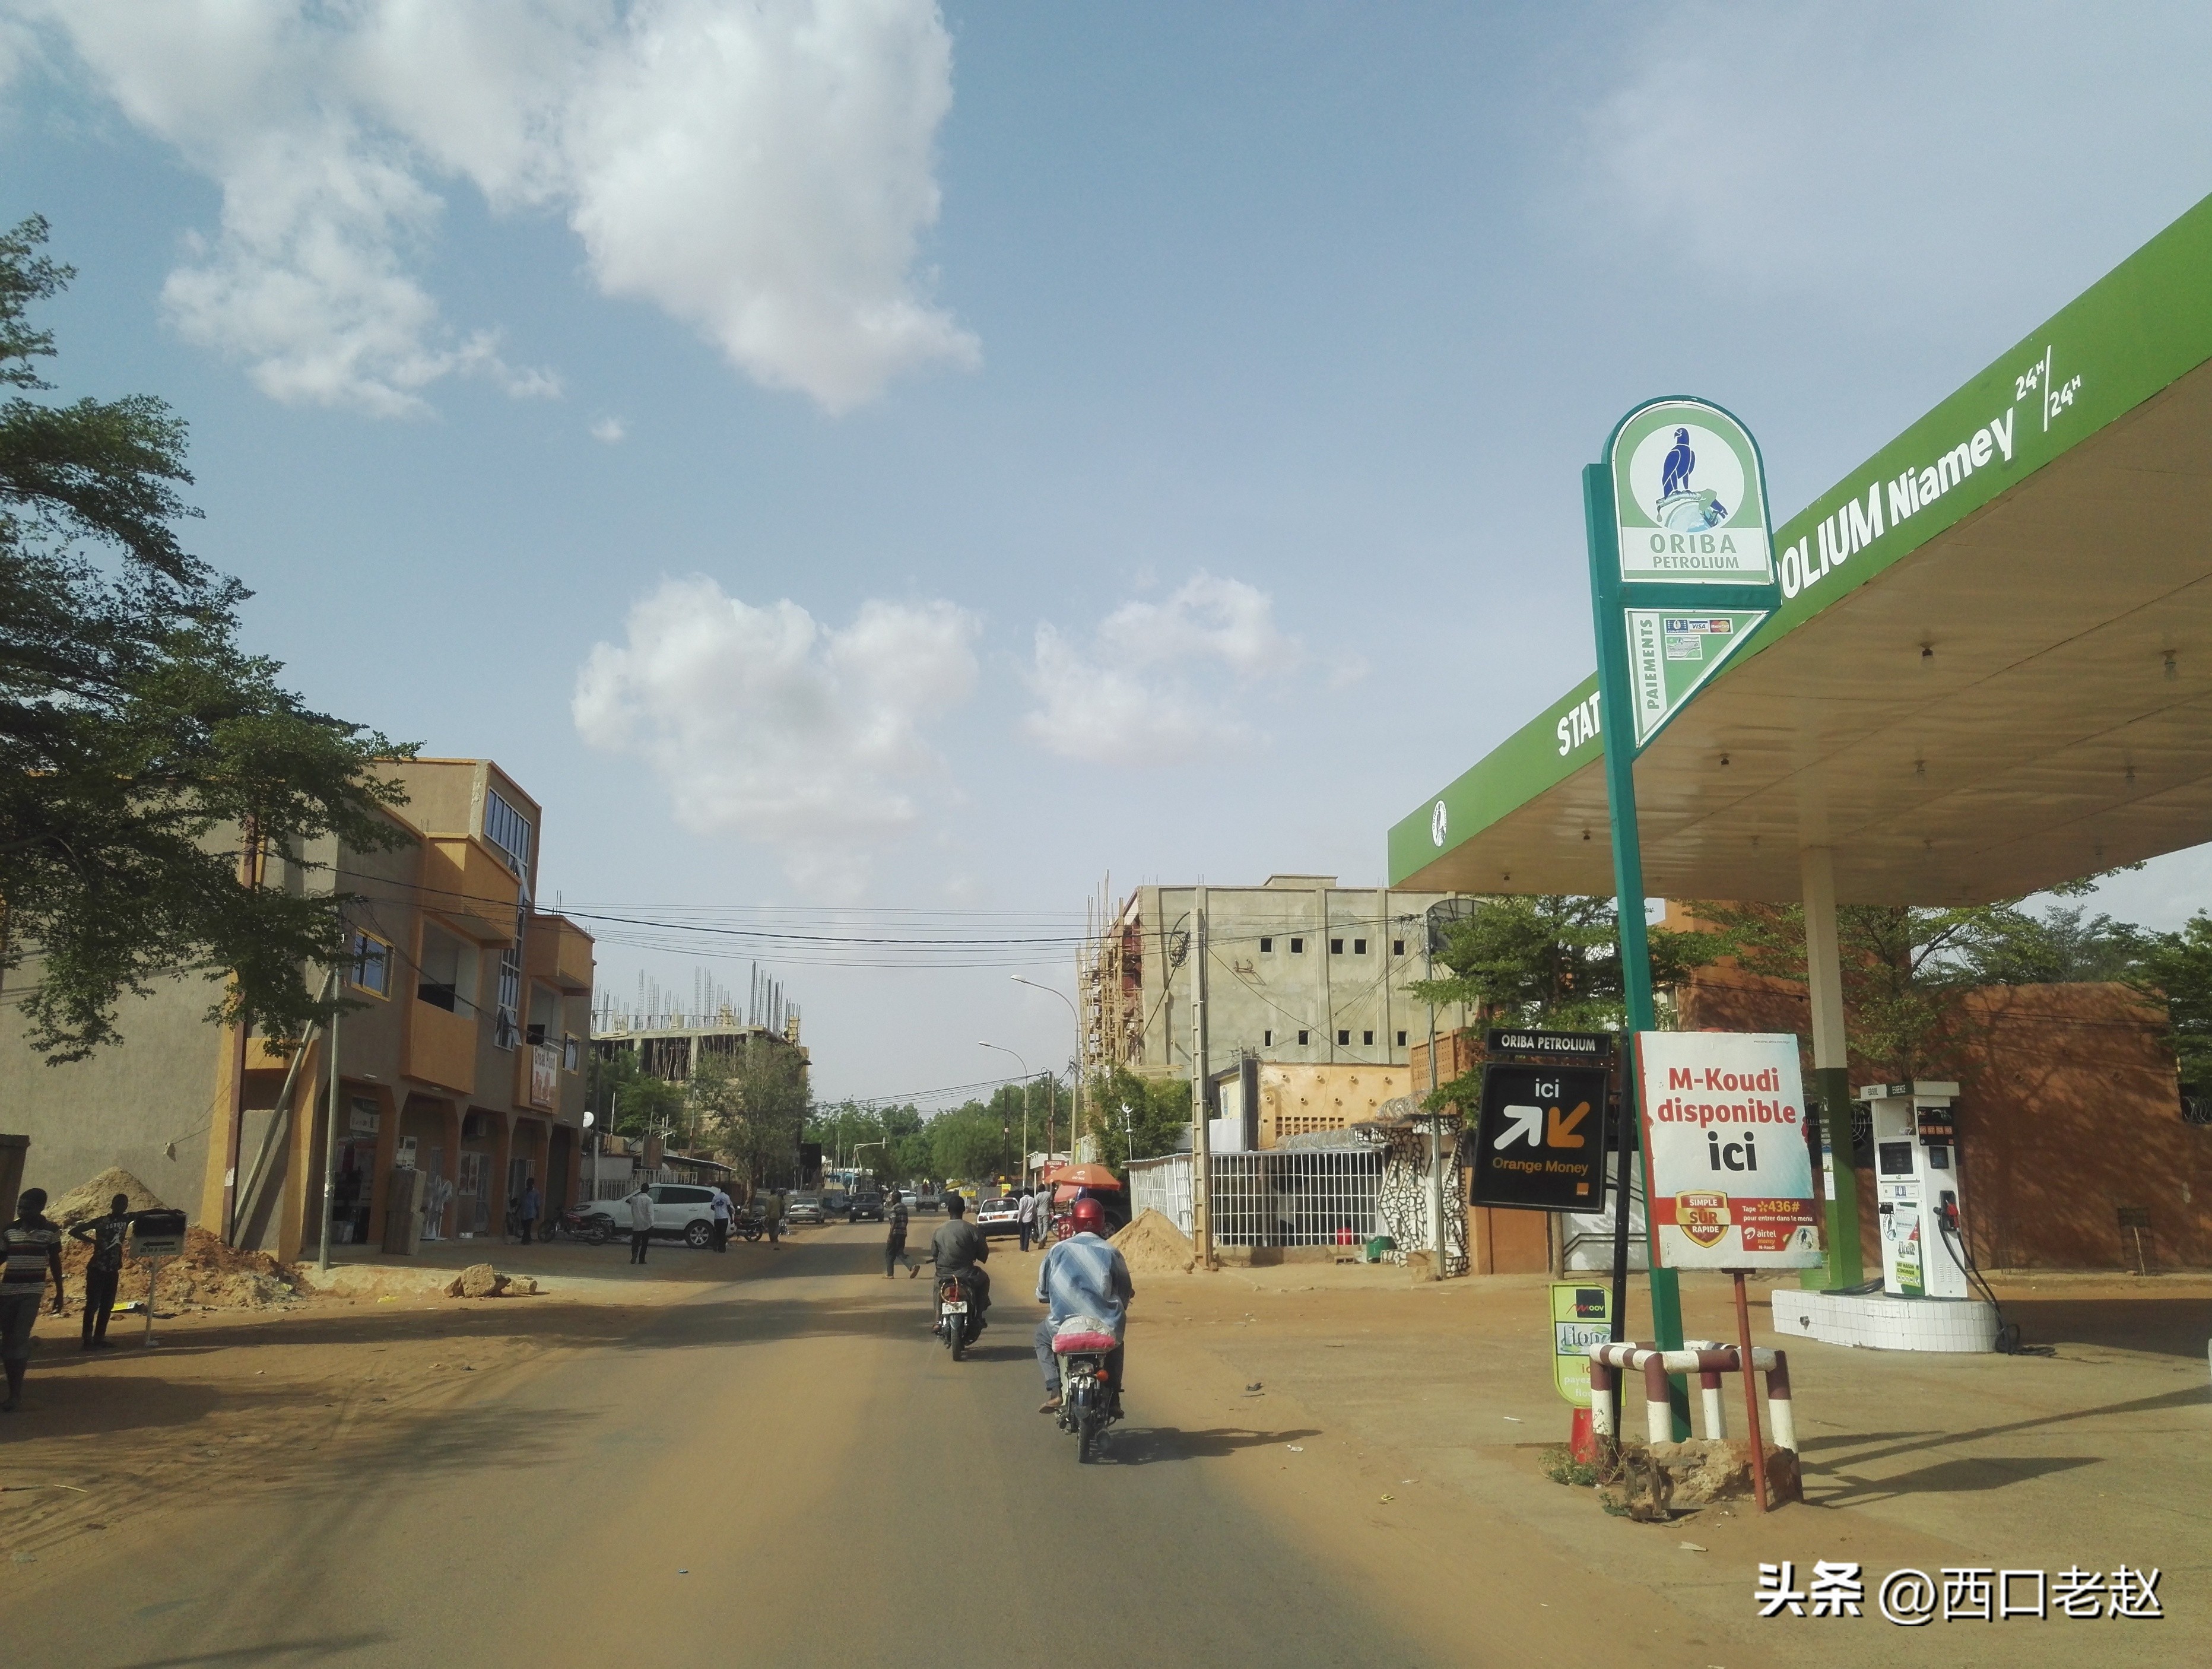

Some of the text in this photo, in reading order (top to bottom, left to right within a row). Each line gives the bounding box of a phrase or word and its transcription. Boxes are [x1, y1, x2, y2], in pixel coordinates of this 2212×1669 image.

[1650, 534, 1737, 554] ORIBA
[1653, 556, 1740, 569] PETROLIUM
[1557, 690, 1601, 756] STAT
[1776, 481, 1884, 605] OLIUM
[1888, 407, 2013, 528] Niamey
[1640, 619, 1659, 709] PAIEMENTS
[1502, 1035, 1595, 1051] ORIBA PETROLIUM
[1535, 1078, 1559, 1098] ici
[1668, 1067, 1780, 1093] M-Koudi
[1657, 1097, 1797, 1128] disponible
[1708, 1131, 1757, 1172] ici
[1493, 1157, 1589, 1176] Orange Money
[1689, 1208, 1718, 1224] SÛR
